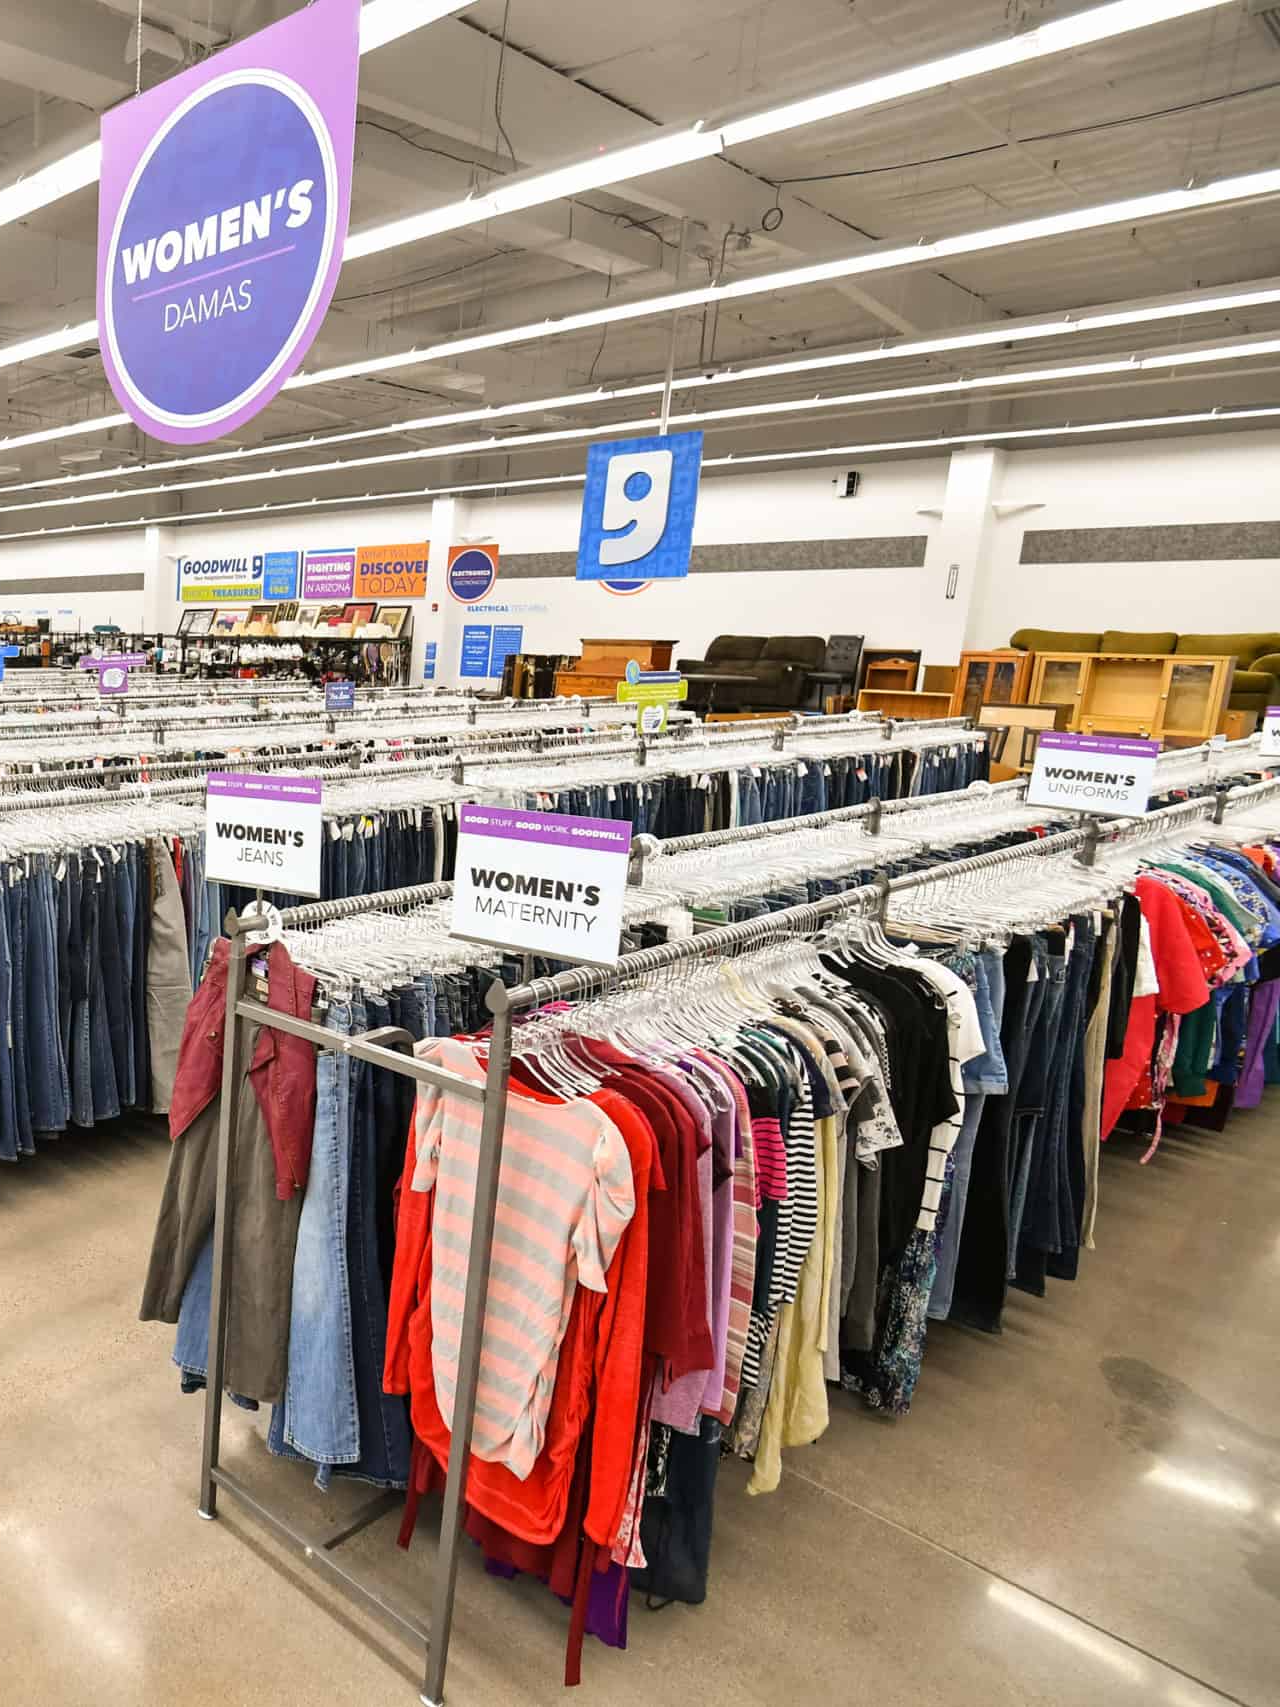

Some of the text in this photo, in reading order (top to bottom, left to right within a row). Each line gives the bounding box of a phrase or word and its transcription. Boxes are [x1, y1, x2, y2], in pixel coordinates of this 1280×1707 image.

[121, 178, 314, 285] WOMEN'S
[162, 279, 254, 332] DAMAS
[183, 558, 248, 575] GOODWILL
[306, 562, 352, 574] FIGHTING
[211, 588, 259, 598] TREASURES
[314, 582, 351, 593] ARIZONA
[360, 577, 418, 593] TODAY
[1044, 766, 1136, 787] WOMEN'S
[1047, 783, 1129, 801] UNIFORMS
[464, 815, 489, 825] GOOD
[515, 821, 542, 831] GOOD
[214, 821, 304, 848] WOMEN'S
[236, 846, 283, 868] JEANS
[469, 867, 600, 907] WOMEN'S
[473, 895, 596, 934] MATERNITY
